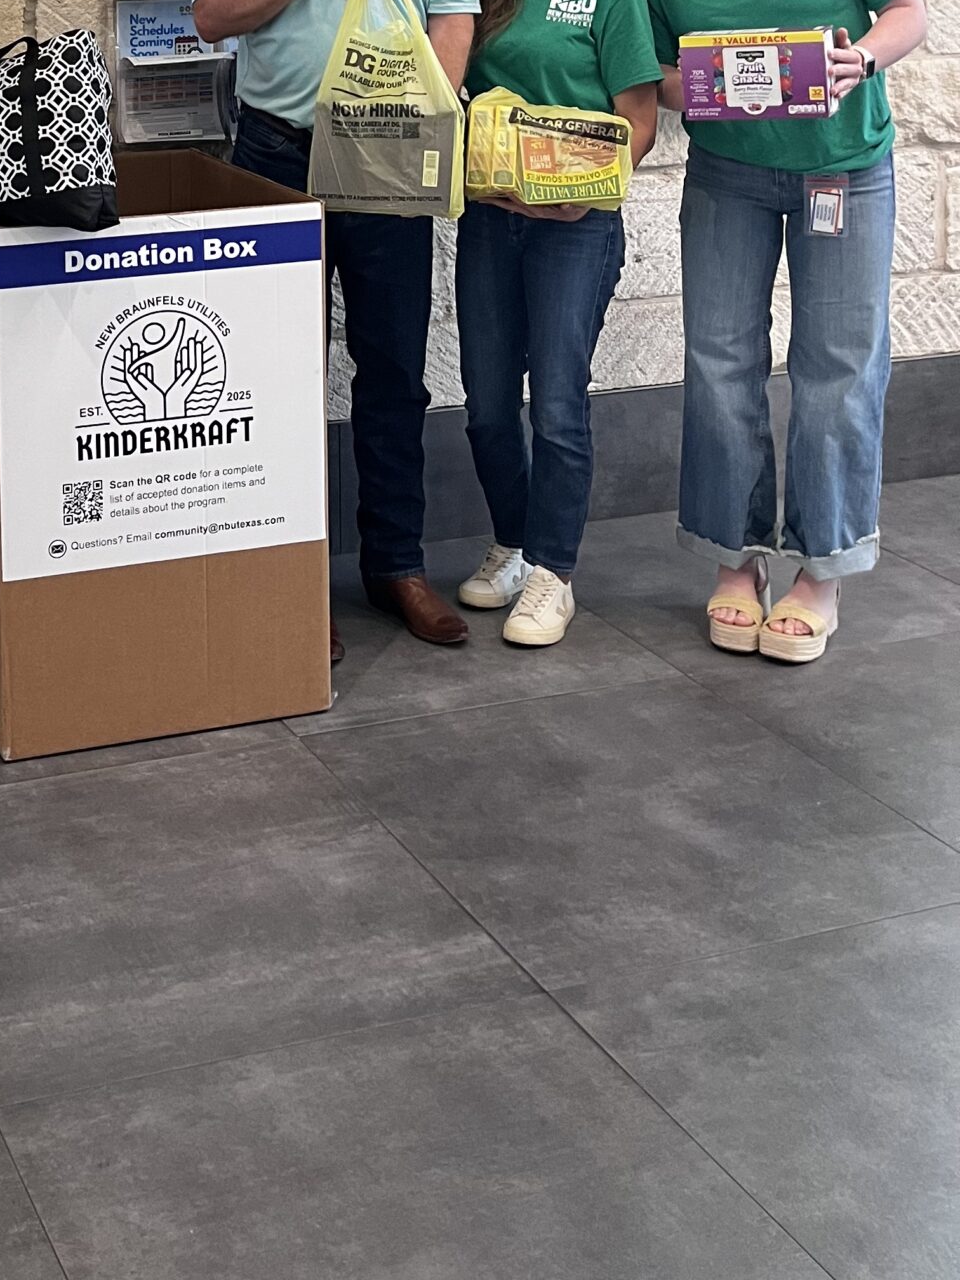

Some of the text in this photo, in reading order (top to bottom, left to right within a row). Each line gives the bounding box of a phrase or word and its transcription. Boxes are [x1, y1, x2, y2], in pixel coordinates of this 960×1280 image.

[129, 13, 157, 25] New
[129, 23, 185, 36] Schedules
[130, 36, 174, 49] Coming
[725, 36, 758, 45] VALUE
[760, 35, 788, 43] PACK
[130, 48, 159, 57] Soon
[344, 47, 376, 74] DG
[380, 58, 415, 70] DIGITAL
[737, 62, 766, 74] Fruit
[386, 81, 402, 89] OUR
[732, 74, 773, 86] Snacks
[331, 101, 425, 118] NOW HIRING.
[516, 109, 624, 139] DOLAR GENERAL
[564, 171, 601, 182] OATMEAL
[530, 177, 617, 200] NATURE VALLEY
[64, 238, 257, 273] Donation Box
[95, 295, 231, 350] NEW BRAUNFELS UTILITIES
[226, 390, 252, 402] 2025
[79, 406, 103, 418] EST.
[76, 416, 254, 462] KINDERKRAFT
[109, 463, 264, 489] Scan the QR code for a complete
[110, 476, 266, 505] list of accepted donation items and
[110, 506, 141, 518] details
[142, 502, 169, 514] about
[170, 500, 186, 511] the
[70, 515, 285, 551] Questions? Email community@nbutexas.com
